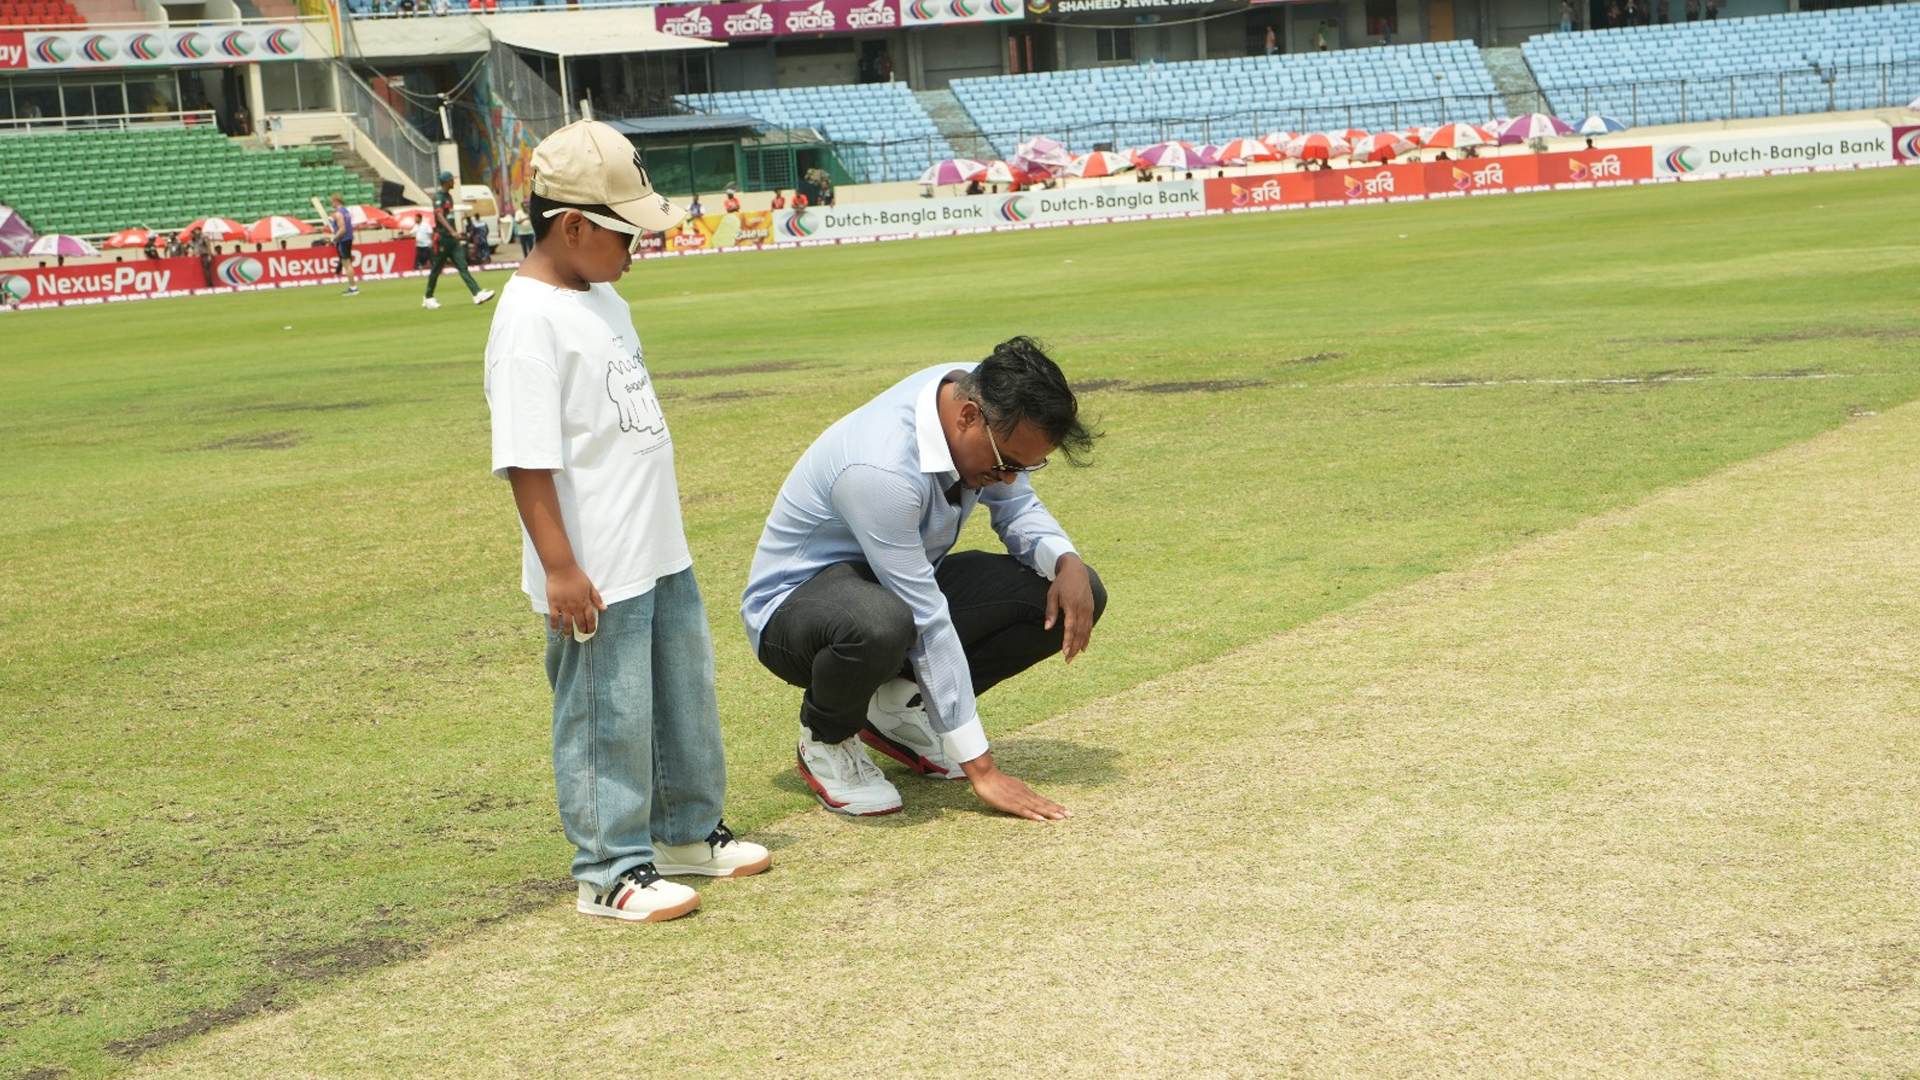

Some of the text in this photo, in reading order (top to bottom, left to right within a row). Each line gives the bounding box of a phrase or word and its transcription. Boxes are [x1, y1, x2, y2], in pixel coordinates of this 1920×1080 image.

[1058, 0, 1121, 13] SHAHEED
[1709, 138, 1885, 164] Dutch-Bangla Bank
[1473, 163, 1503, 187] রবি
[1590, 154, 1621, 179] রবি
[1251, 180, 1281, 203] রবি
[1364, 171, 1394, 195] রবি
[1041, 189, 1199, 213] Dutch-Bangla Bank
[825, 208, 936, 228] Dutch-Bangla
[942, 205, 983, 220] Bank
[674, 235, 705, 247] Polar
[36, 267, 170, 296] NexusPay
